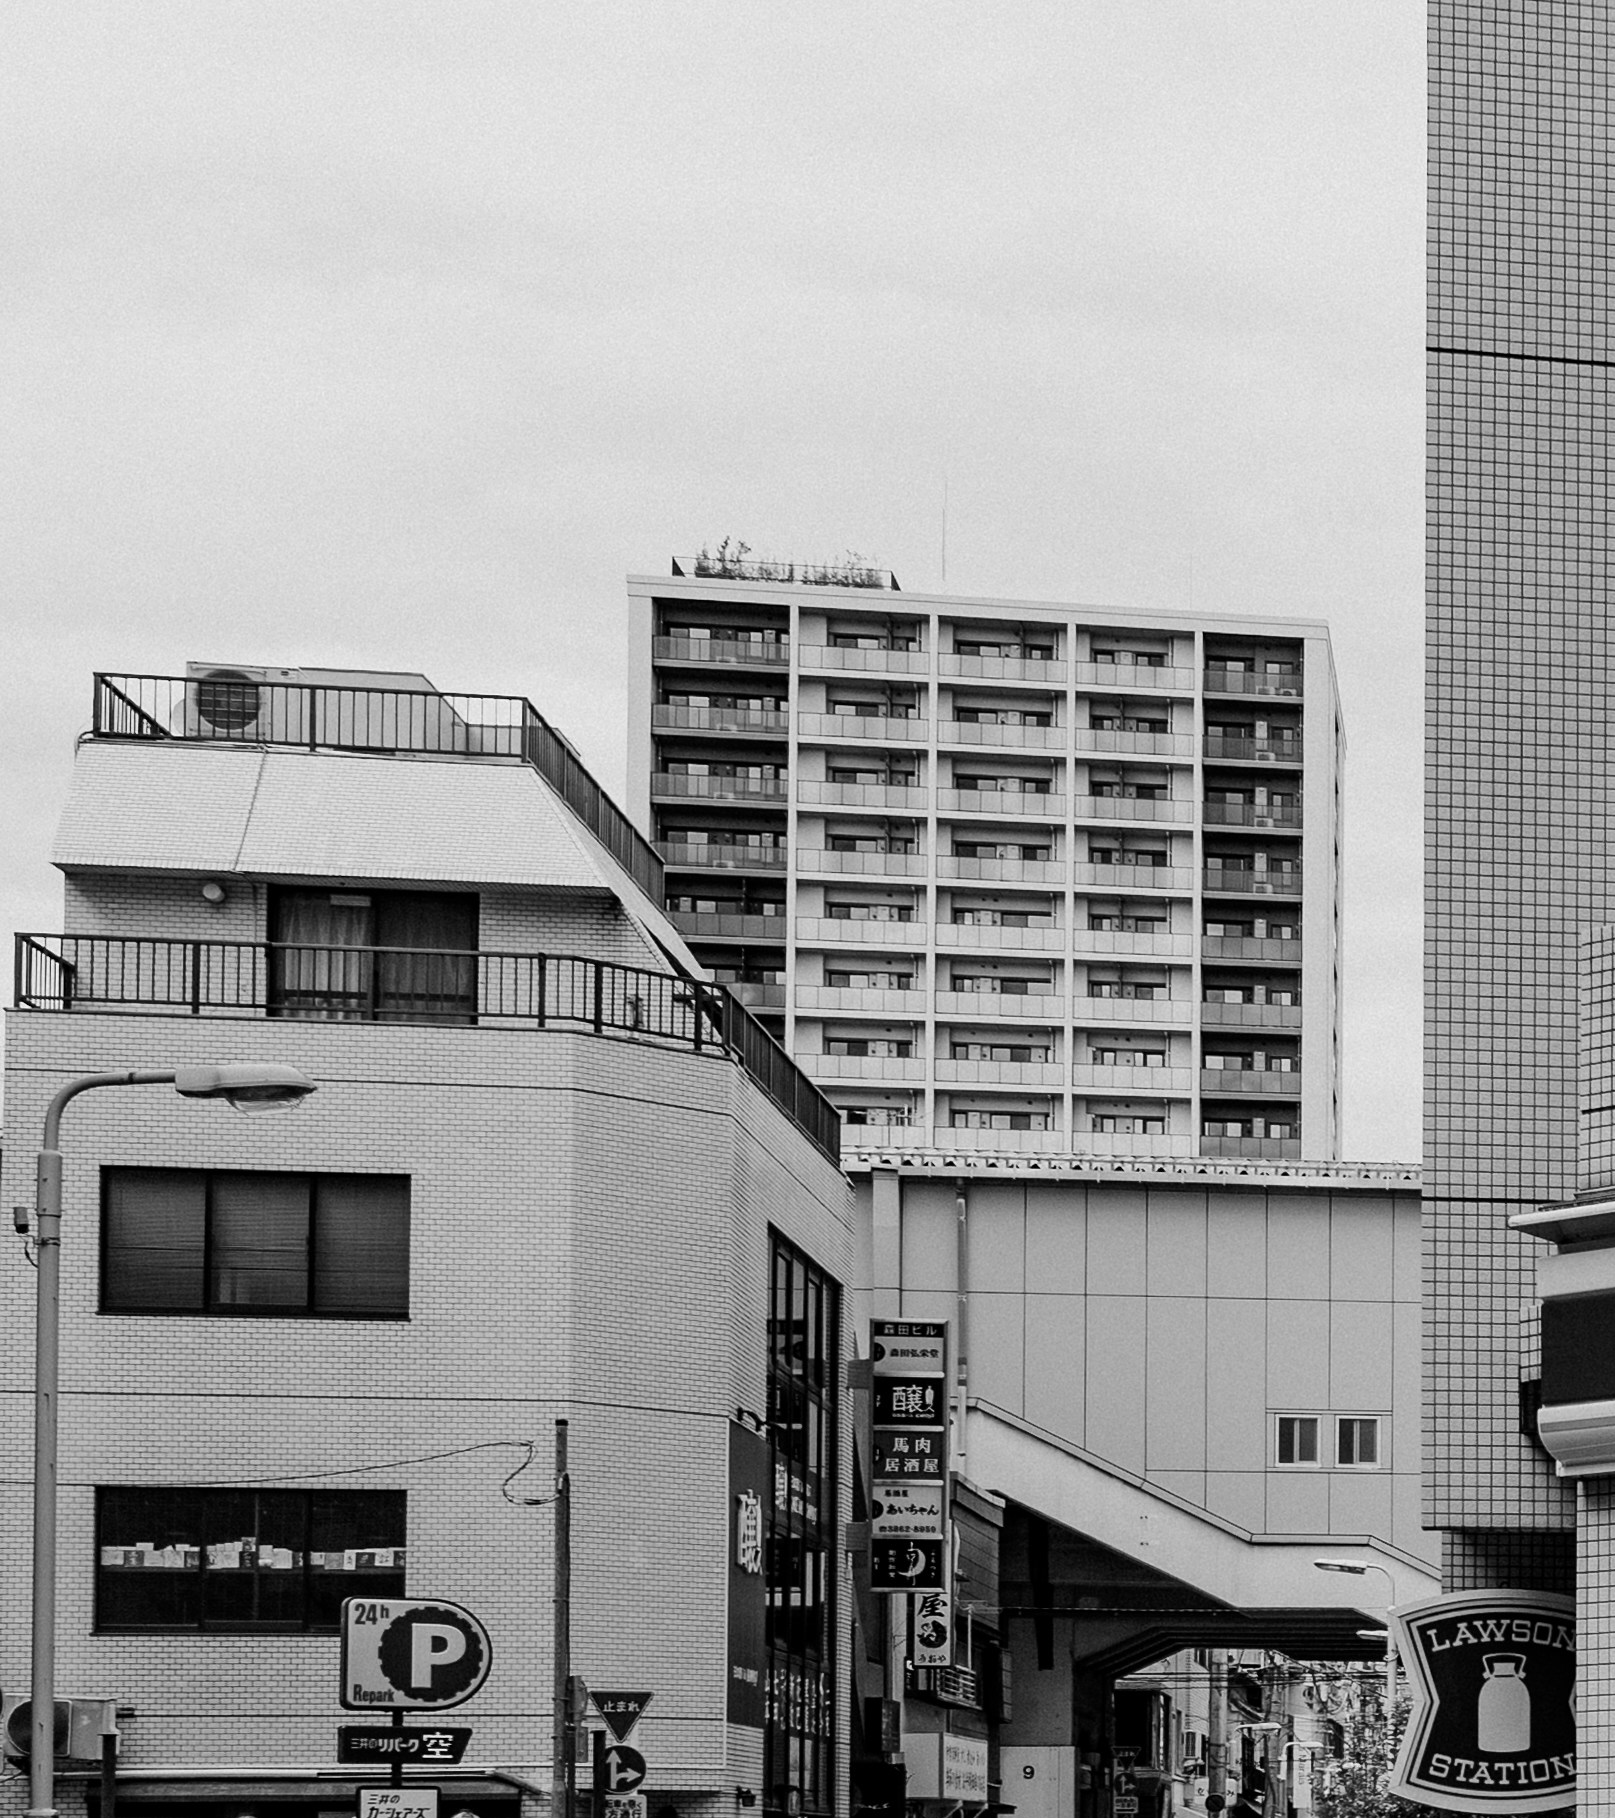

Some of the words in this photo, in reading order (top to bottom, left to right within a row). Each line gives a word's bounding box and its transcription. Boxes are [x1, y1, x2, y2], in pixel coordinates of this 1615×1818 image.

[893, 1437, 931, 1453] 馬肉
[885, 1458, 939, 1473] 居酒屋
[1427, 1619, 1576, 1653] LAWSON
[411, 1623, 467, 1689] P
[353, 1684, 395, 1704] Repark
[603, 1701, 640, 1712] 止まれ
[422, 1732, 454, 1759] 空
[1023, 1766, 1035, 1779] 9
[1429, 1752, 1576, 1785] STATION
